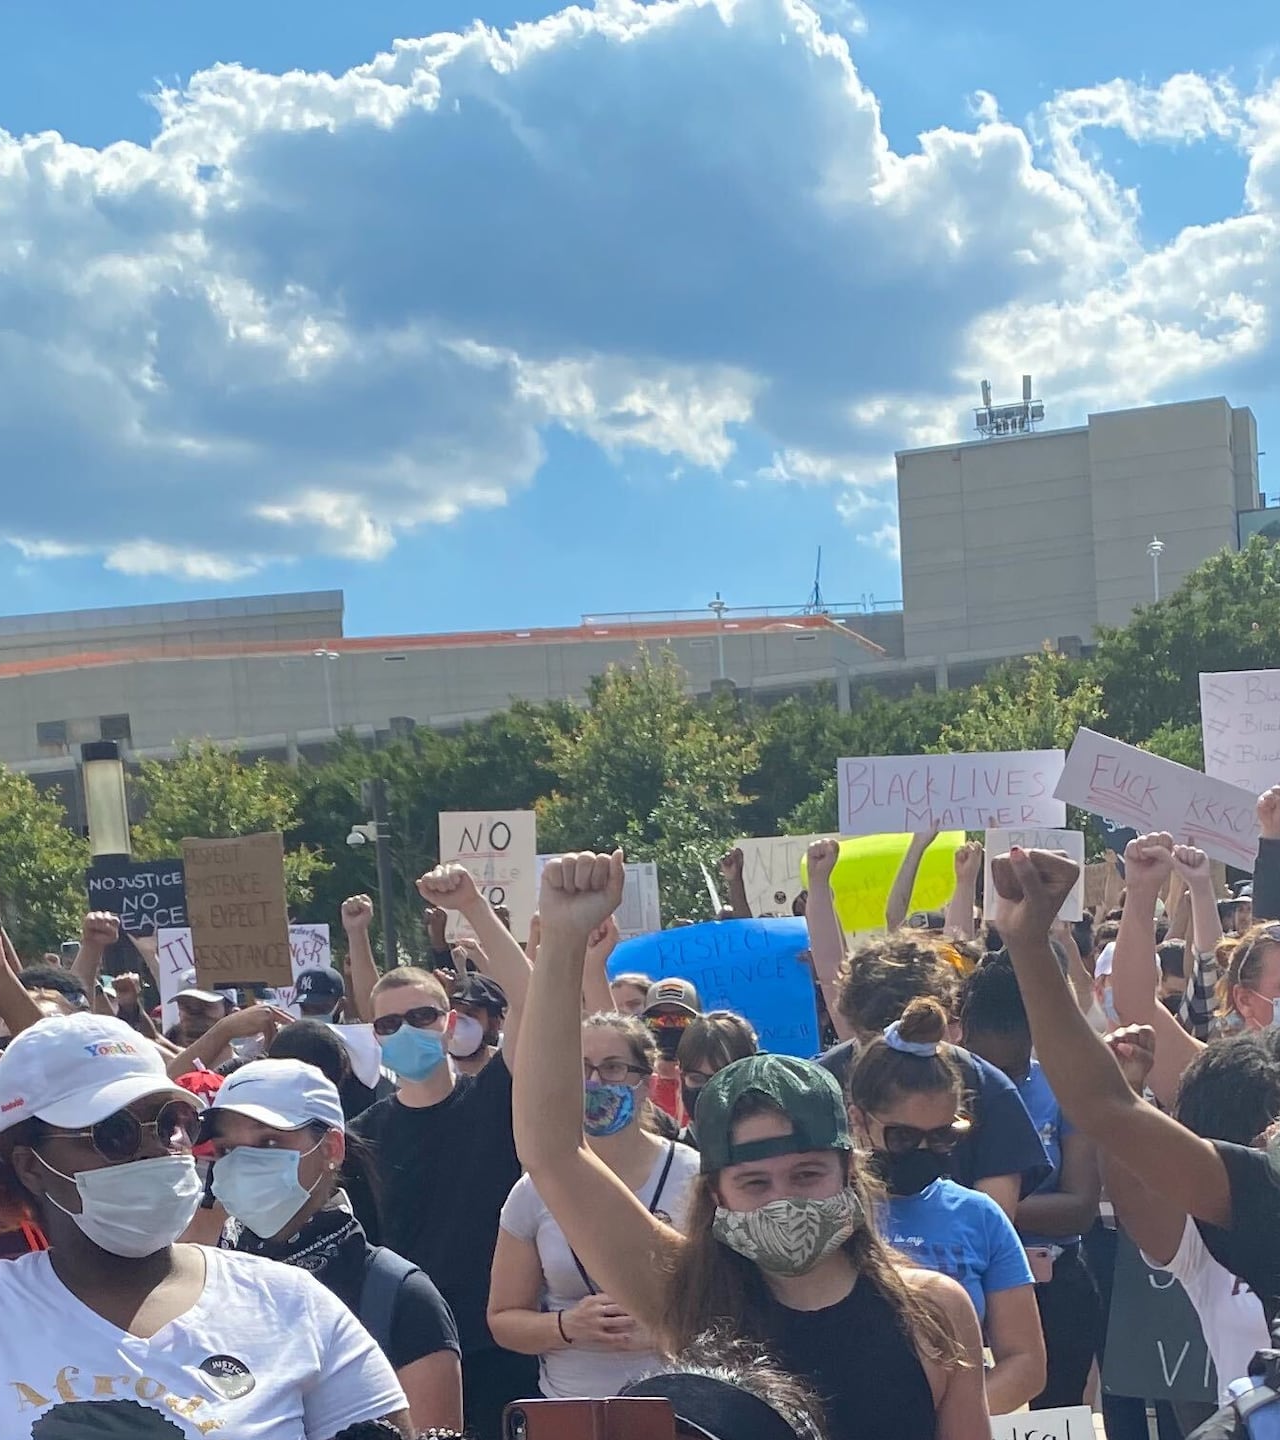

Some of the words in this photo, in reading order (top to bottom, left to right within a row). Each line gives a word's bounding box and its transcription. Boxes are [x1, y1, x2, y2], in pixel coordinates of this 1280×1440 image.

[950, 763, 1046, 802] LIVES
[1089, 754, 1161, 811] FUCK
[904, 804, 1042, 833] MATTER
[459, 821, 511, 852] NO
[89, 877, 115, 891] NO
[117, 872, 184, 890] JUSTICE
[122, 893, 159, 913] NO
[120, 905, 186, 932] EACE
